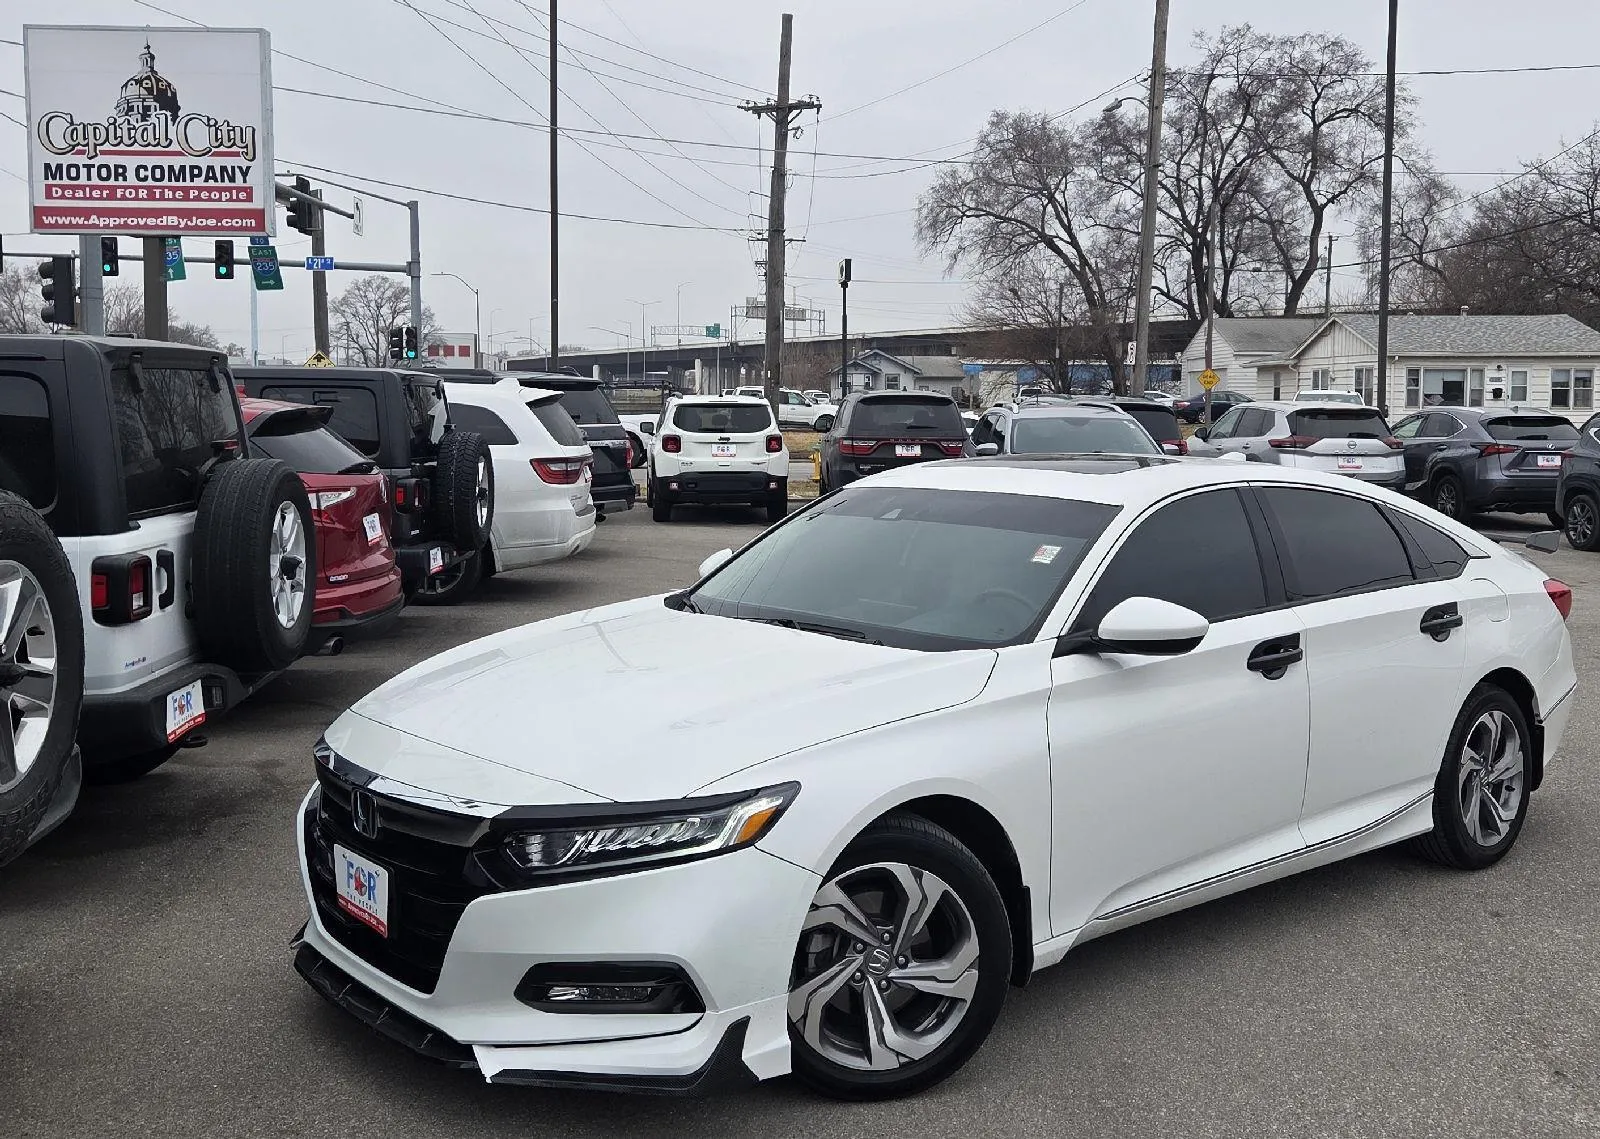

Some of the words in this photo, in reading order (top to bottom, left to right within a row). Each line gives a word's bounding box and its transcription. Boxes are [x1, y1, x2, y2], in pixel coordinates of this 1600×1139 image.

[38, 111, 172, 160] Capital
[176, 112, 256, 162] City
[43, 163, 128, 182] MOTOR
[134, 164, 252, 184] COMPANY
[52, 187, 110, 198] Dealer
[116, 188, 148, 199] FOR
[153, 189, 184, 199] The
[189, 189, 247, 202] People
[42, 214, 256, 228] www.ApprovedByJoe.com
[166, 251, 178, 260] 35
[256, 262, 275, 271] 235
[347, 860, 377, 904] FOR
